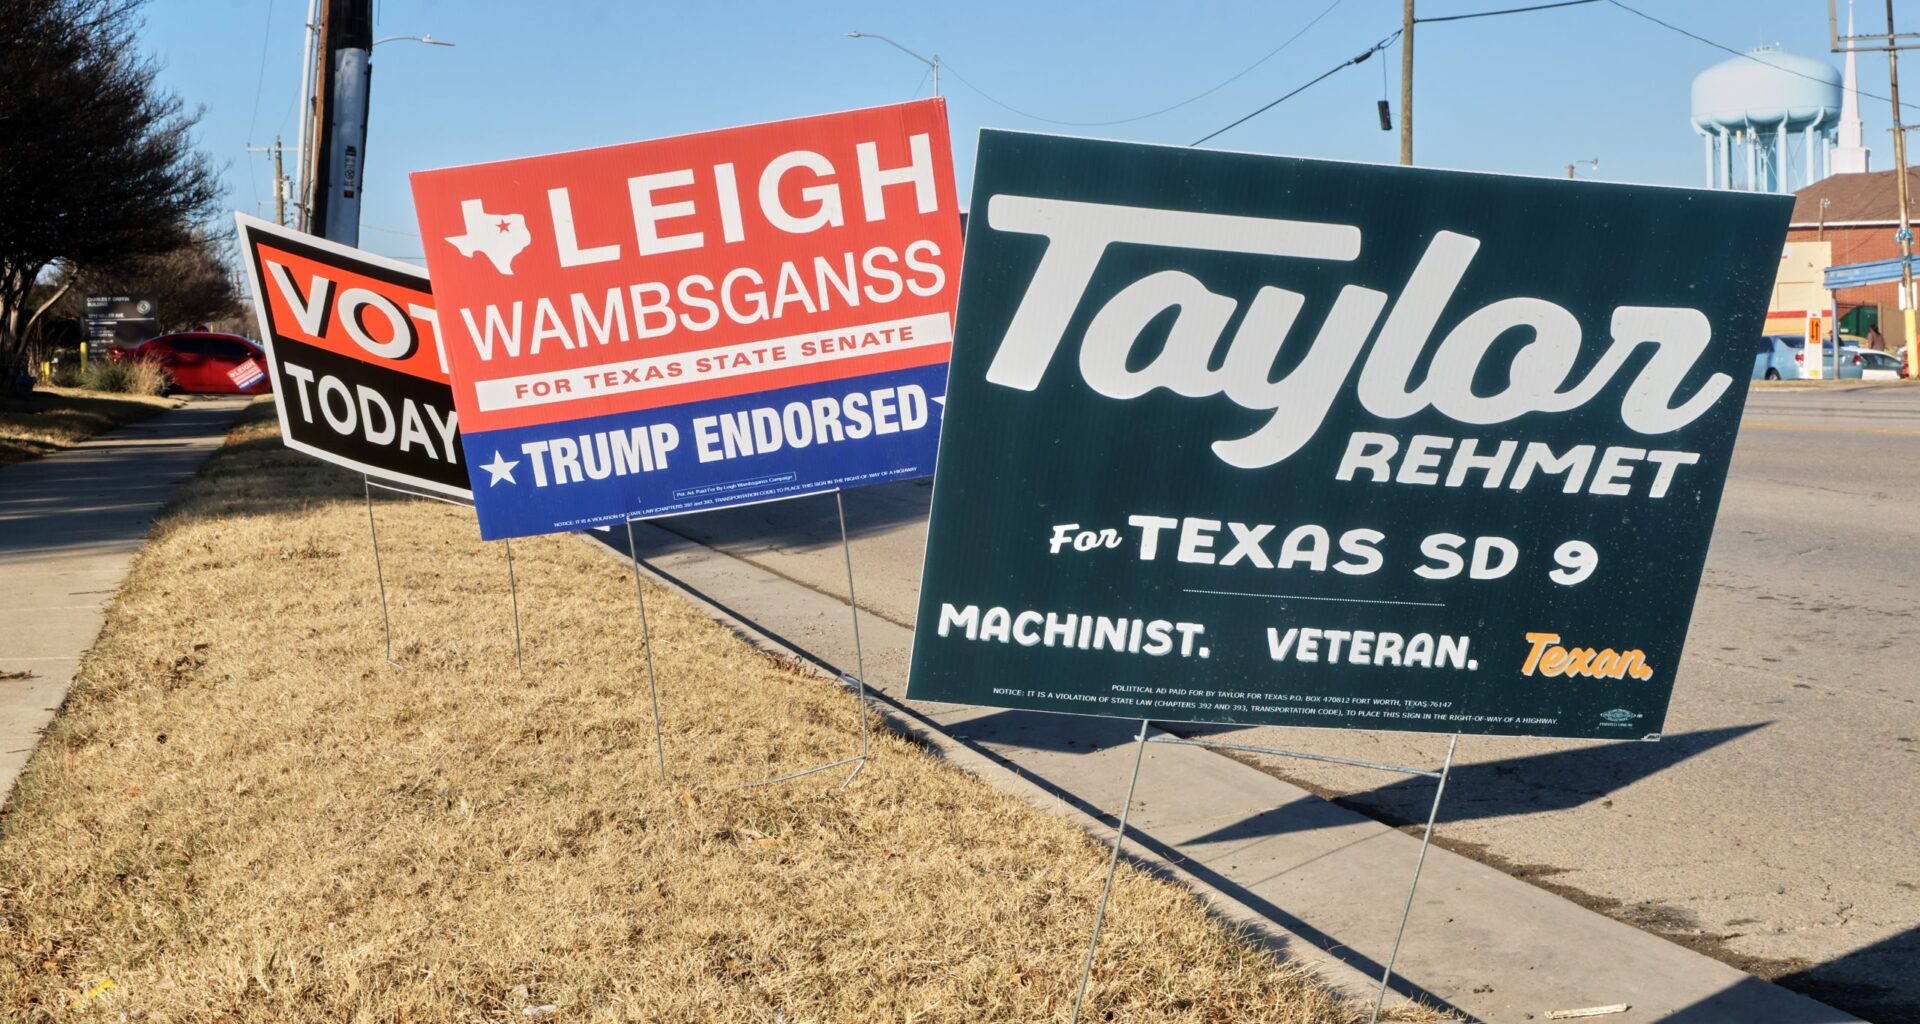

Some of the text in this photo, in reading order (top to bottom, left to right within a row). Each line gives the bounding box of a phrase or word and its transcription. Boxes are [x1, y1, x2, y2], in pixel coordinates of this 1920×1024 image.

[546, 132, 939, 268] LEIGH
[265, 259, 450, 374] VOT
[460, 239, 947, 361] WAMBSGANSS
[985, 194, 1733, 469] Taylor
[515, 325, 915, 400] FOR TEXAS STATE SENATE
[284, 361, 458, 464] TODAY
[521, 383, 928, 488] TRUMP ENDORSED
[715, 492, 759, 503] TRANSPORTATION
[1335, 431, 1700, 498] REHMET
[1049, 515, 1599, 585] For TEXAS SD 9
[937, 602, 1653, 680] MACHINIST. VETERAN. Texan.
[993, 687, 1025, 696] NOTICE:
[1055, 693, 1097, 702] VIOLATION
[1111, 697, 1134, 705] STATE
[1154, 699, 1196, 709] (CHAPTERS
[1251, 705, 1316, 714] TRANSPORTATION
[1317, 708, 1343, 716] CODE),
